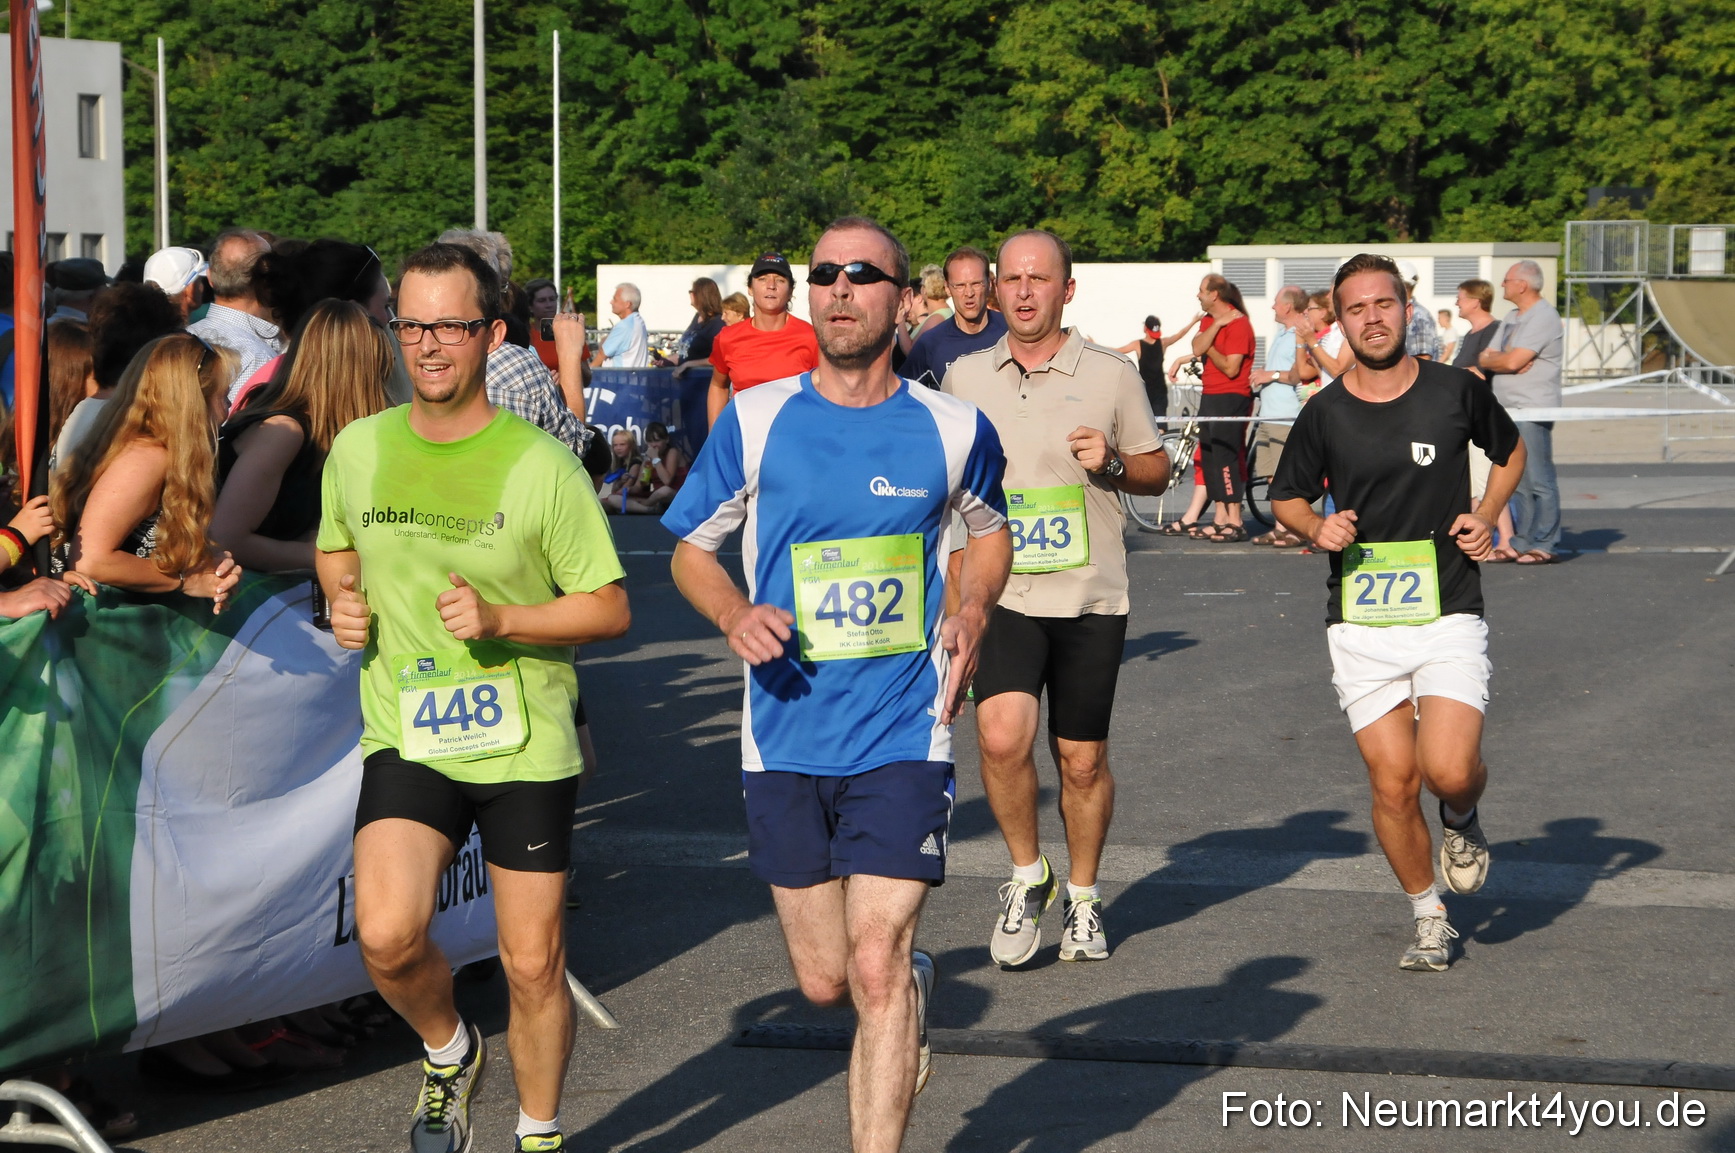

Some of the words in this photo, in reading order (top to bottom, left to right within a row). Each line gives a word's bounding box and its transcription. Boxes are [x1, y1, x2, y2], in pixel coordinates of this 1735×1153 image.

[897, 487, 929, 498] classic
[394, 529, 439, 540] Understand.
[441, 533, 472, 546] Perform.
[1008, 516, 1071, 552] 843
[813, 557, 860, 570] firmenlauf
[1354, 571, 1423, 605] 272
[815, 577, 904, 628] 482
[847, 630, 870, 638] Stefan
[853, 639, 874, 648] classic
[409, 667, 452, 681] firmenlauf
[412, 684, 503, 735] 448
[428, 746, 449, 755] Global
[450, 743, 479, 754] Concepts
[480, 739, 500, 749] GmbH
[438, 735, 463, 744] Patrick
